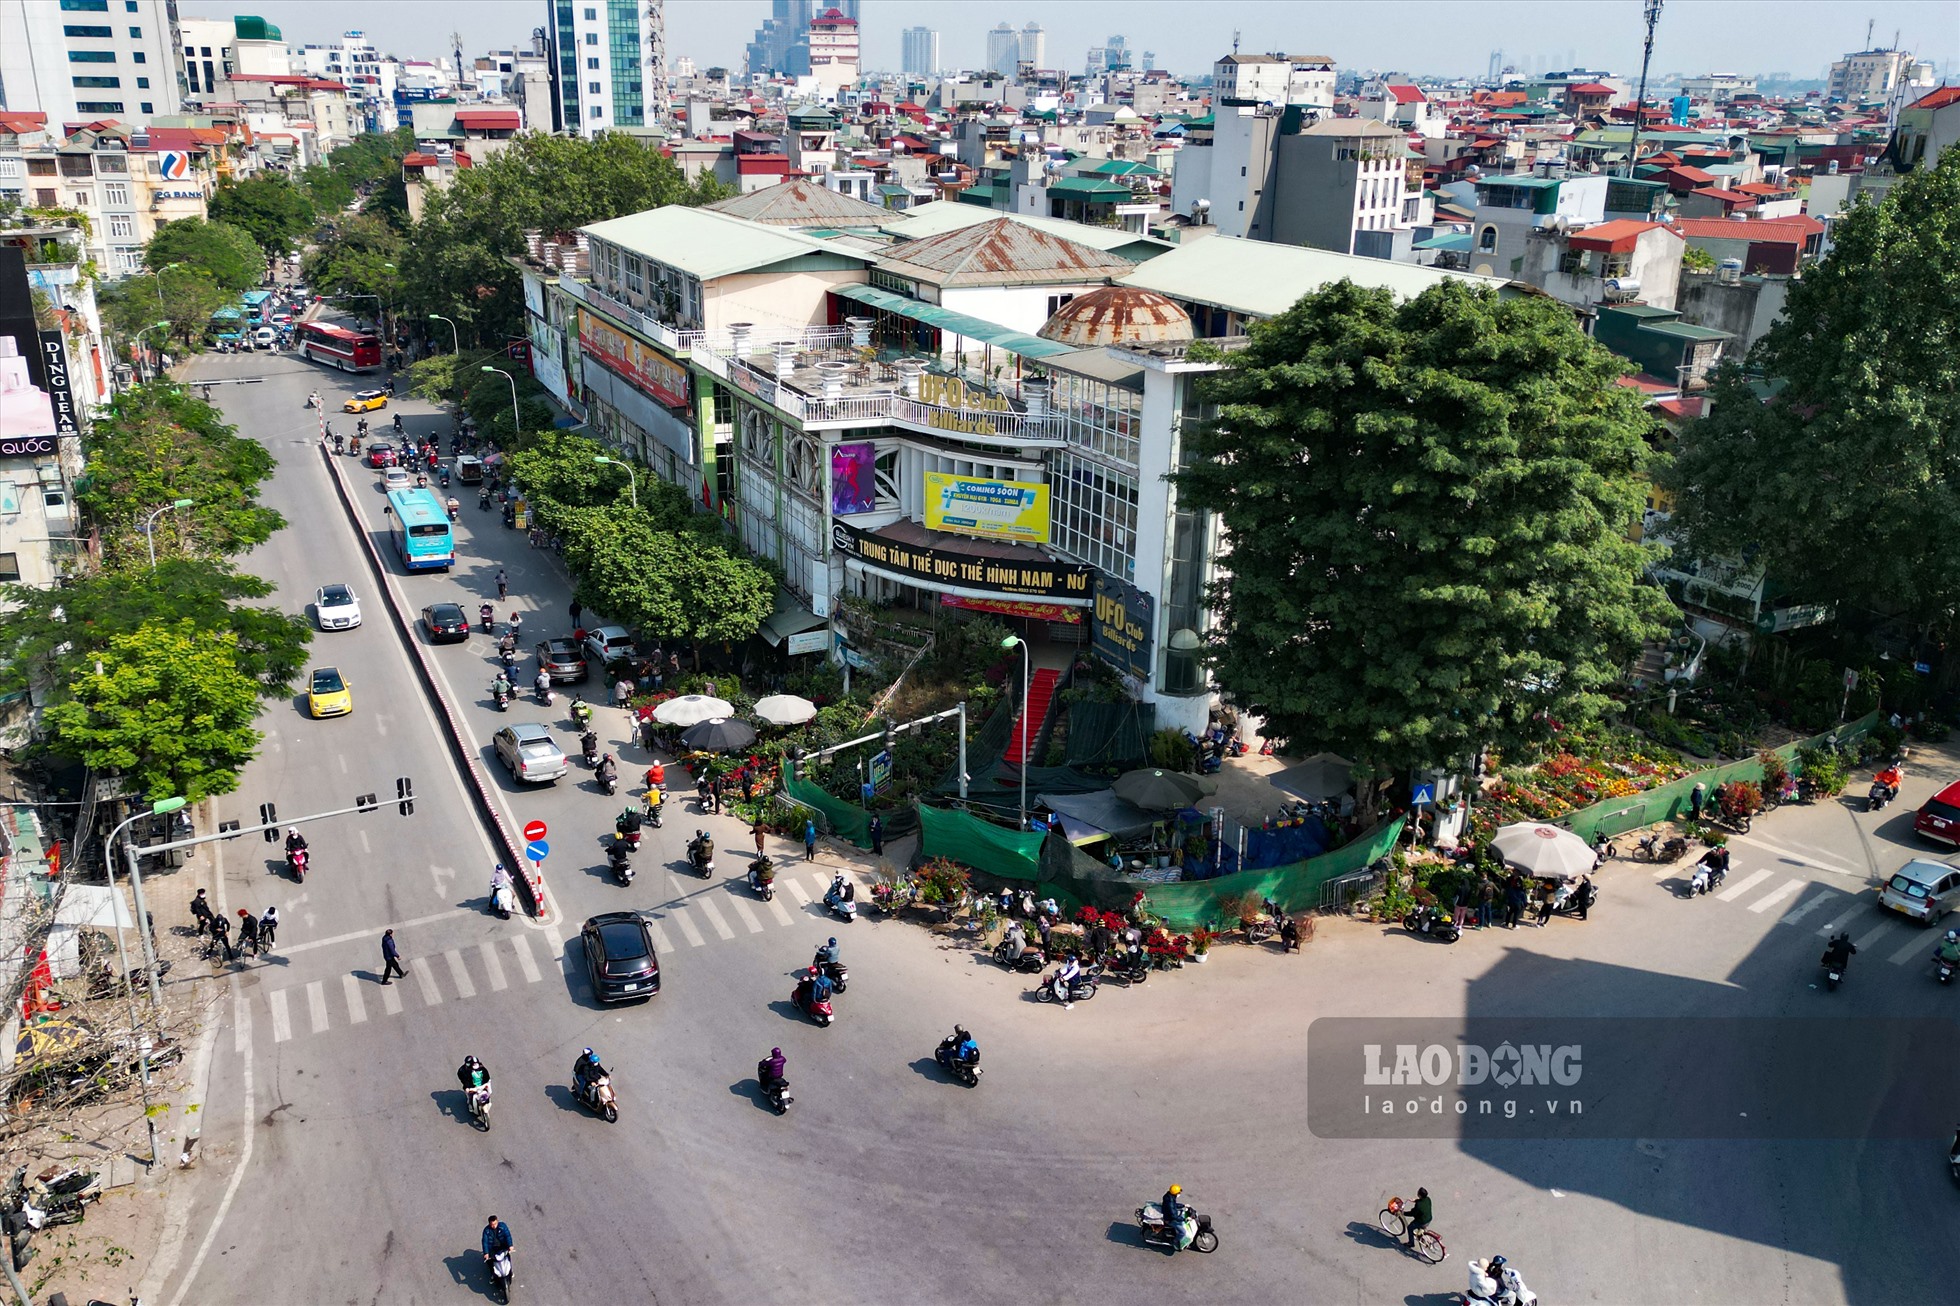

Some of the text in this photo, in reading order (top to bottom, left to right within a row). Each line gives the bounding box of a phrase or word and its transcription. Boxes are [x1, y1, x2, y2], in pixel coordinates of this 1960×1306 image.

[155, 191, 171, 199] PG
[45, 342, 65, 387] DING
[54, 391, 73, 424] TEA
[918, 373, 1008, 412] UFO Club
[928, 411, 996, 435] Billiards
[1, 438, 52, 455] QUỐC
[966, 485, 1018, 497] COMING SOON
[859, 539, 887, 562] TRUNG
[889, 545, 910, 568] TÂM
[912, 550, 933, 573] THỂ
[935, 559, 957, 580] DỤC
[961, 558, 984, 581] THỂ
[987, 564, 1017, 585] HÌNH
[1021, 570, 1053, 588] NAM
[1095, 592, 1145, 641] UFO Club
[1102, 624, 1137, 653] Billiards
